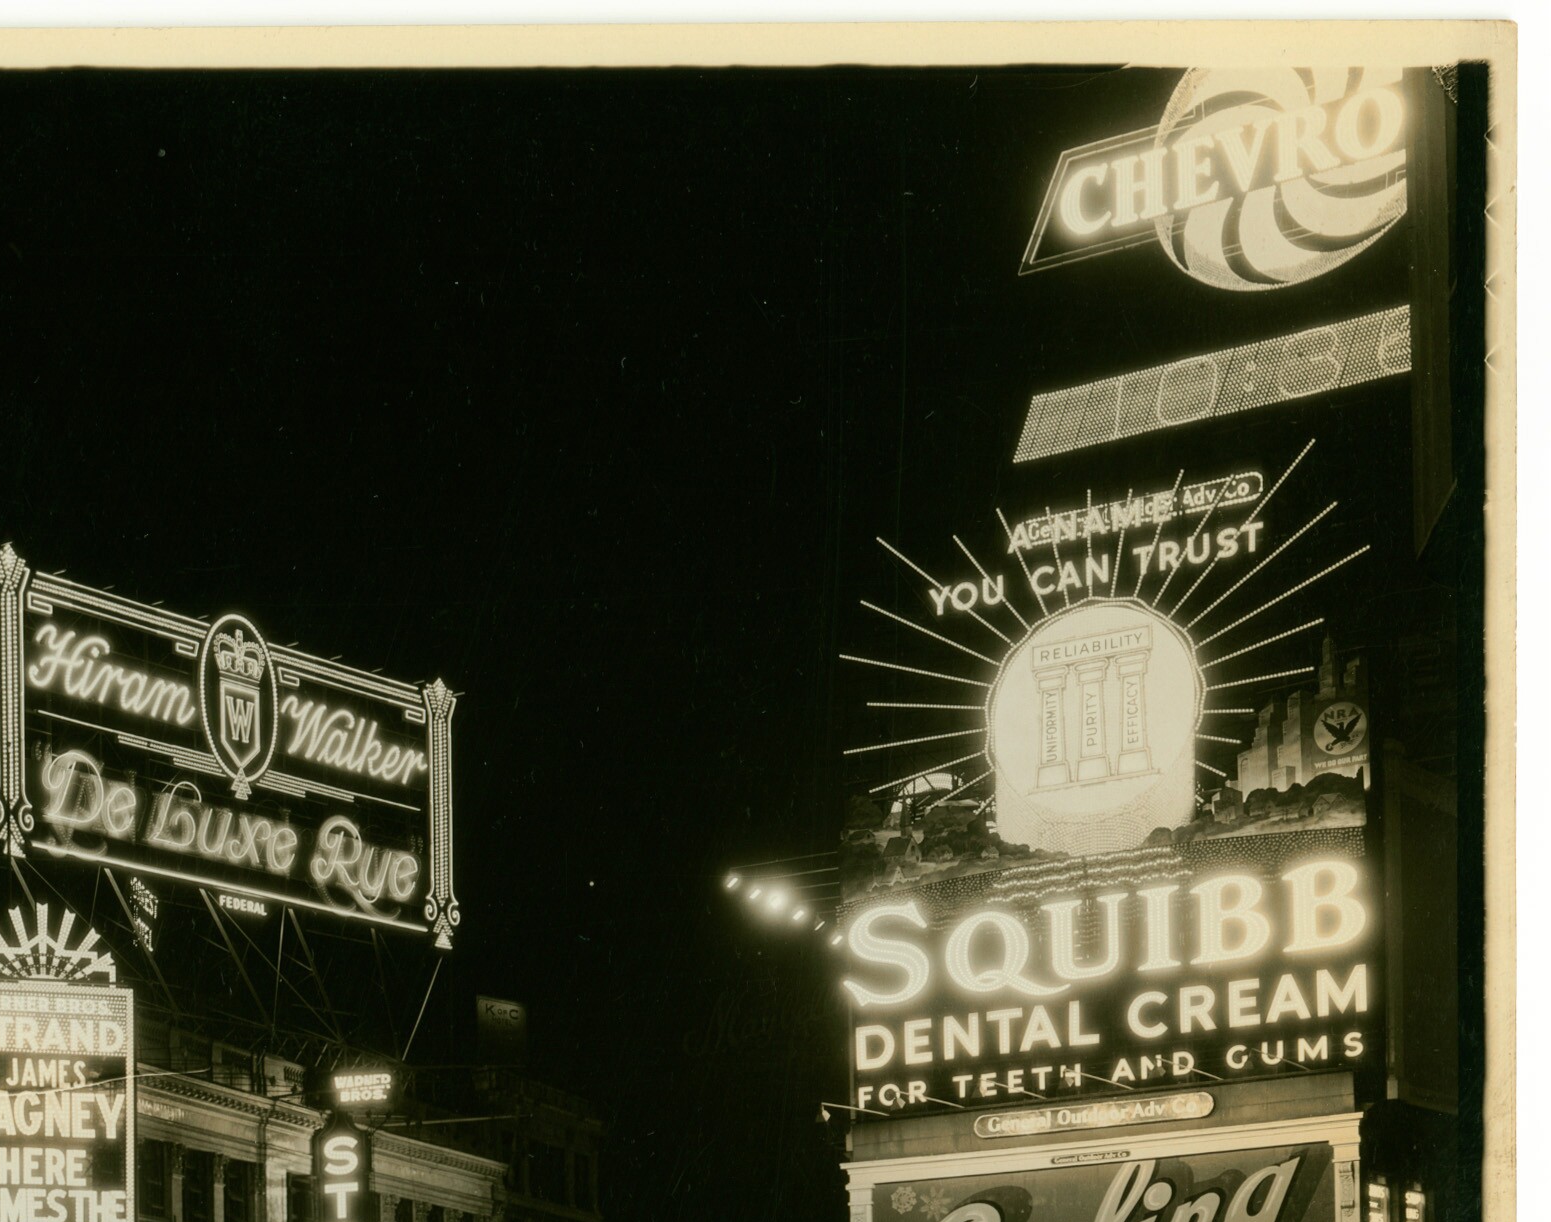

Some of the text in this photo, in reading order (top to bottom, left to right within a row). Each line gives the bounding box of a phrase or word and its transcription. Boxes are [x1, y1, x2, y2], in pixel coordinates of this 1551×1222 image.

[1007, 494, 1172, 553] A NAME
[929, 522, 1264, 617] YOU CAN TRUST
[1040, 632, 1143, 662] RELIABILITY
[27, 623, 428, 785] Hiram Walker
[1045, 691, 1059, 763] UNIFORMITY
[1085, 692, 1098, 747] PURITY
[1126, 680, 1139, 744] EFFICACY
[1324, 707, 1359, 721] NRA
[151, 781, 300, 872] Luxe
[218, 895, 268, 917] FEDERAL
[843, 860, 1368, 1007] SQUIBB
[855, 964, 1368, 1071] DENTAL CREAM
[5, 1057, 87, 1089] JAMES
[858, 1031, 1365, 1110] FOR TEETH AND GUMS
[987, 1099, 1197, 1133] General Outdoor Adv Co
